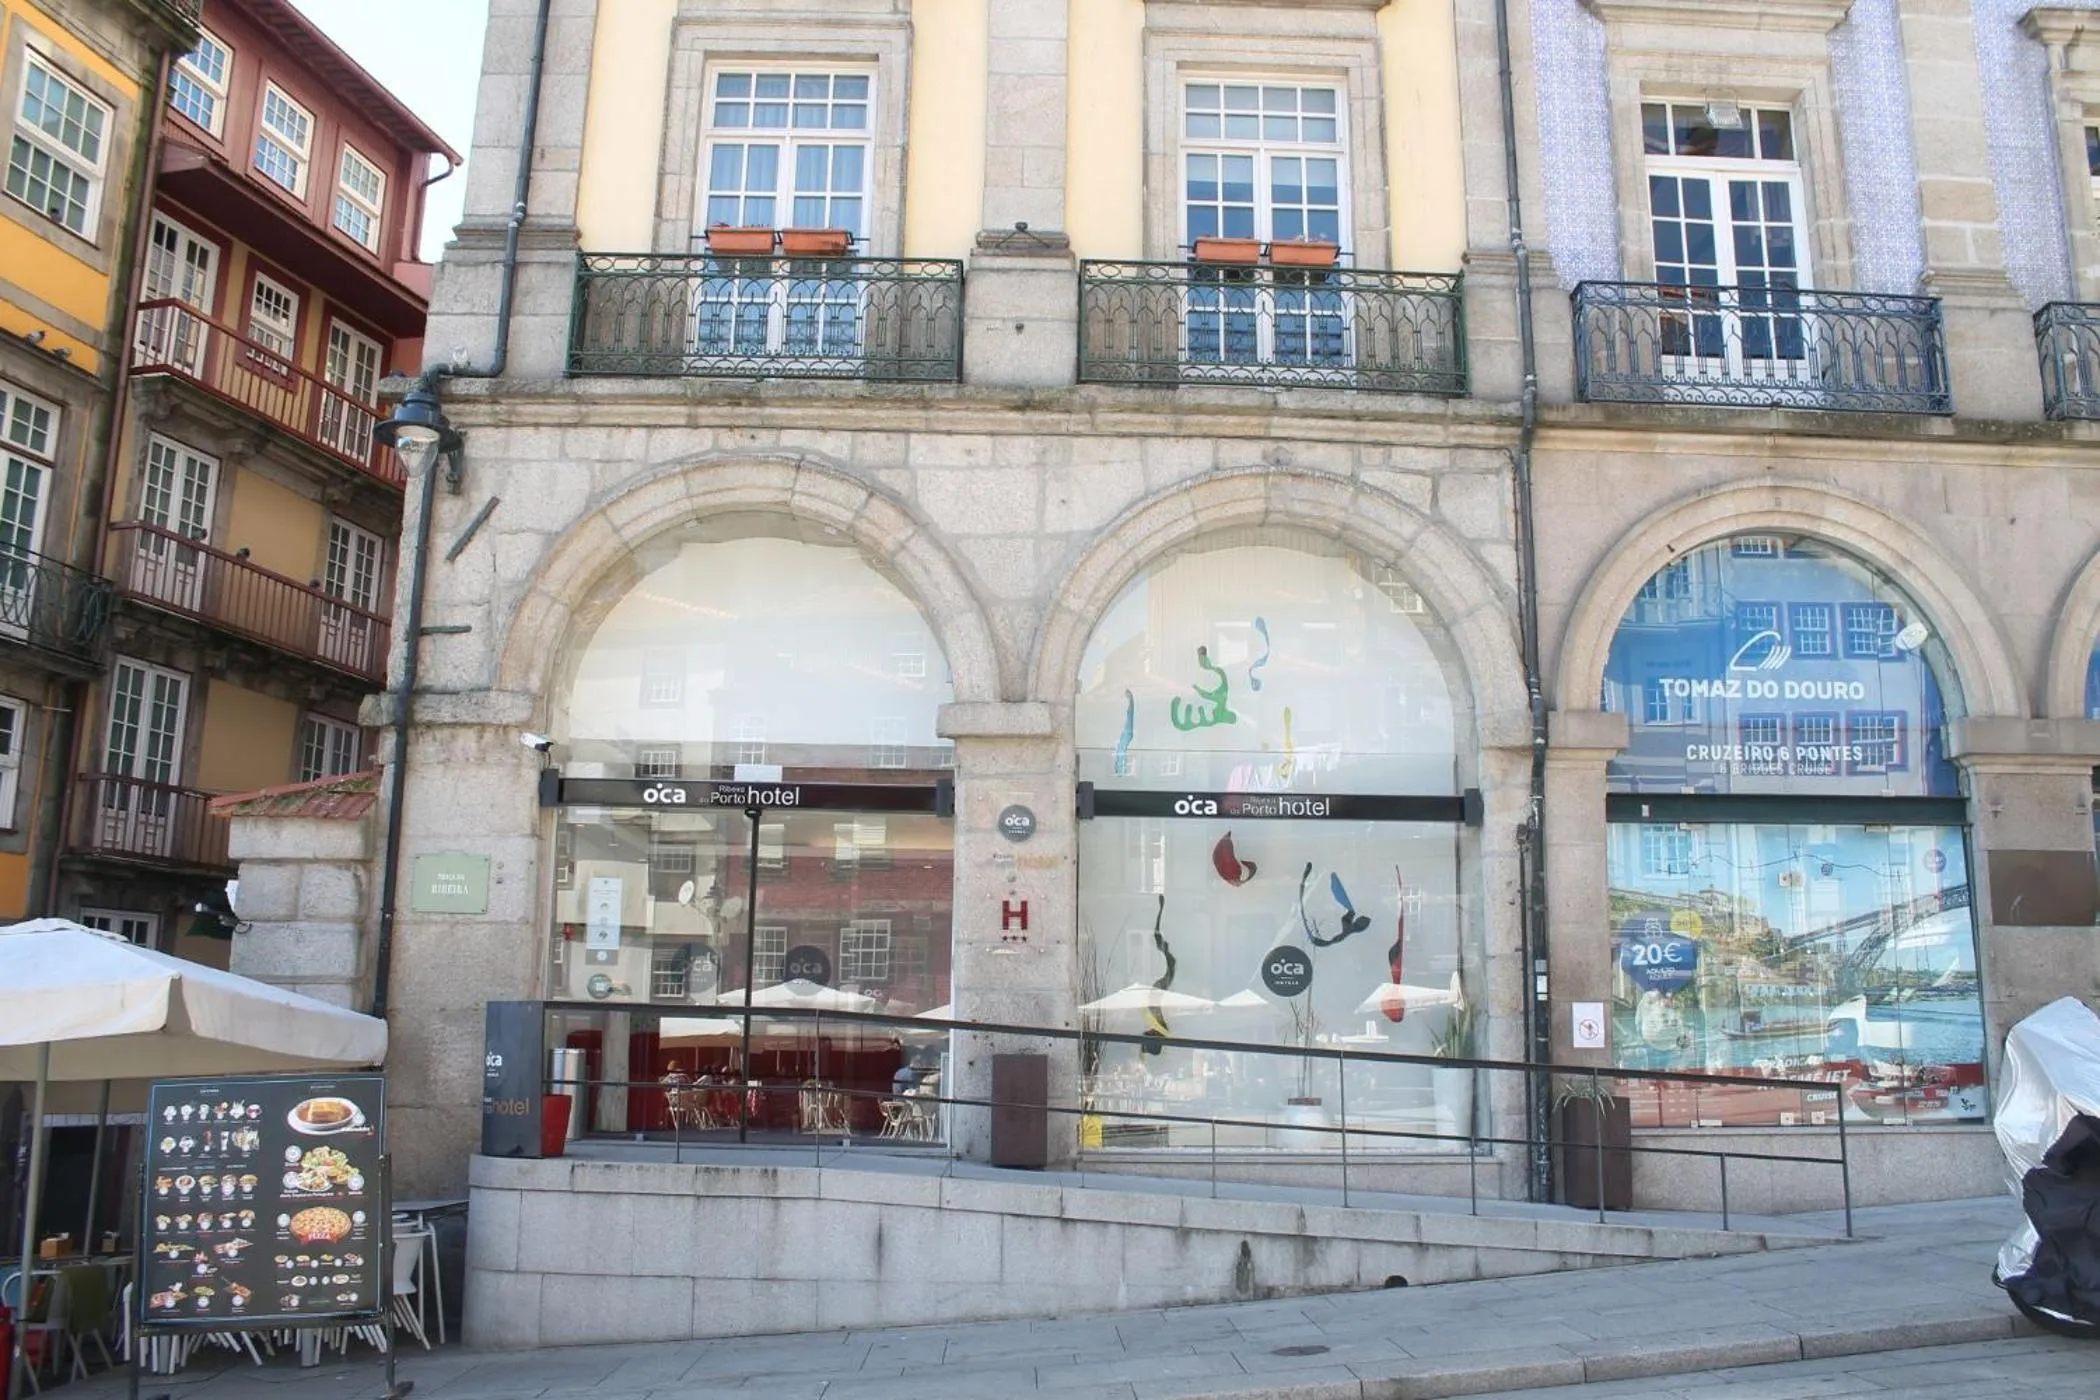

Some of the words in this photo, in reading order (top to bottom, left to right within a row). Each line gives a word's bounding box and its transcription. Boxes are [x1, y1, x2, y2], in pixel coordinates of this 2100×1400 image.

[1659, 678, 1741, 698] TOMAZ
[1747, 680, 1779, 698] DO
[1785, 681, 1865, 700] DOURO
[1686, 744, 1773, 761] CRUZEIRO
[1778, 746, 1790, 761] 6
[1797, 746, 1863, 761] PONTES
[710, 791, 746, 804] Porto
[748, 786, 800, 806] hotel
[1242, 803, 1277, 815] Porto
[1279, 797, 1330, 816] hotel
[1002, 900, 1029, 931] H
[1632, 942, 1684, 966] 20€
